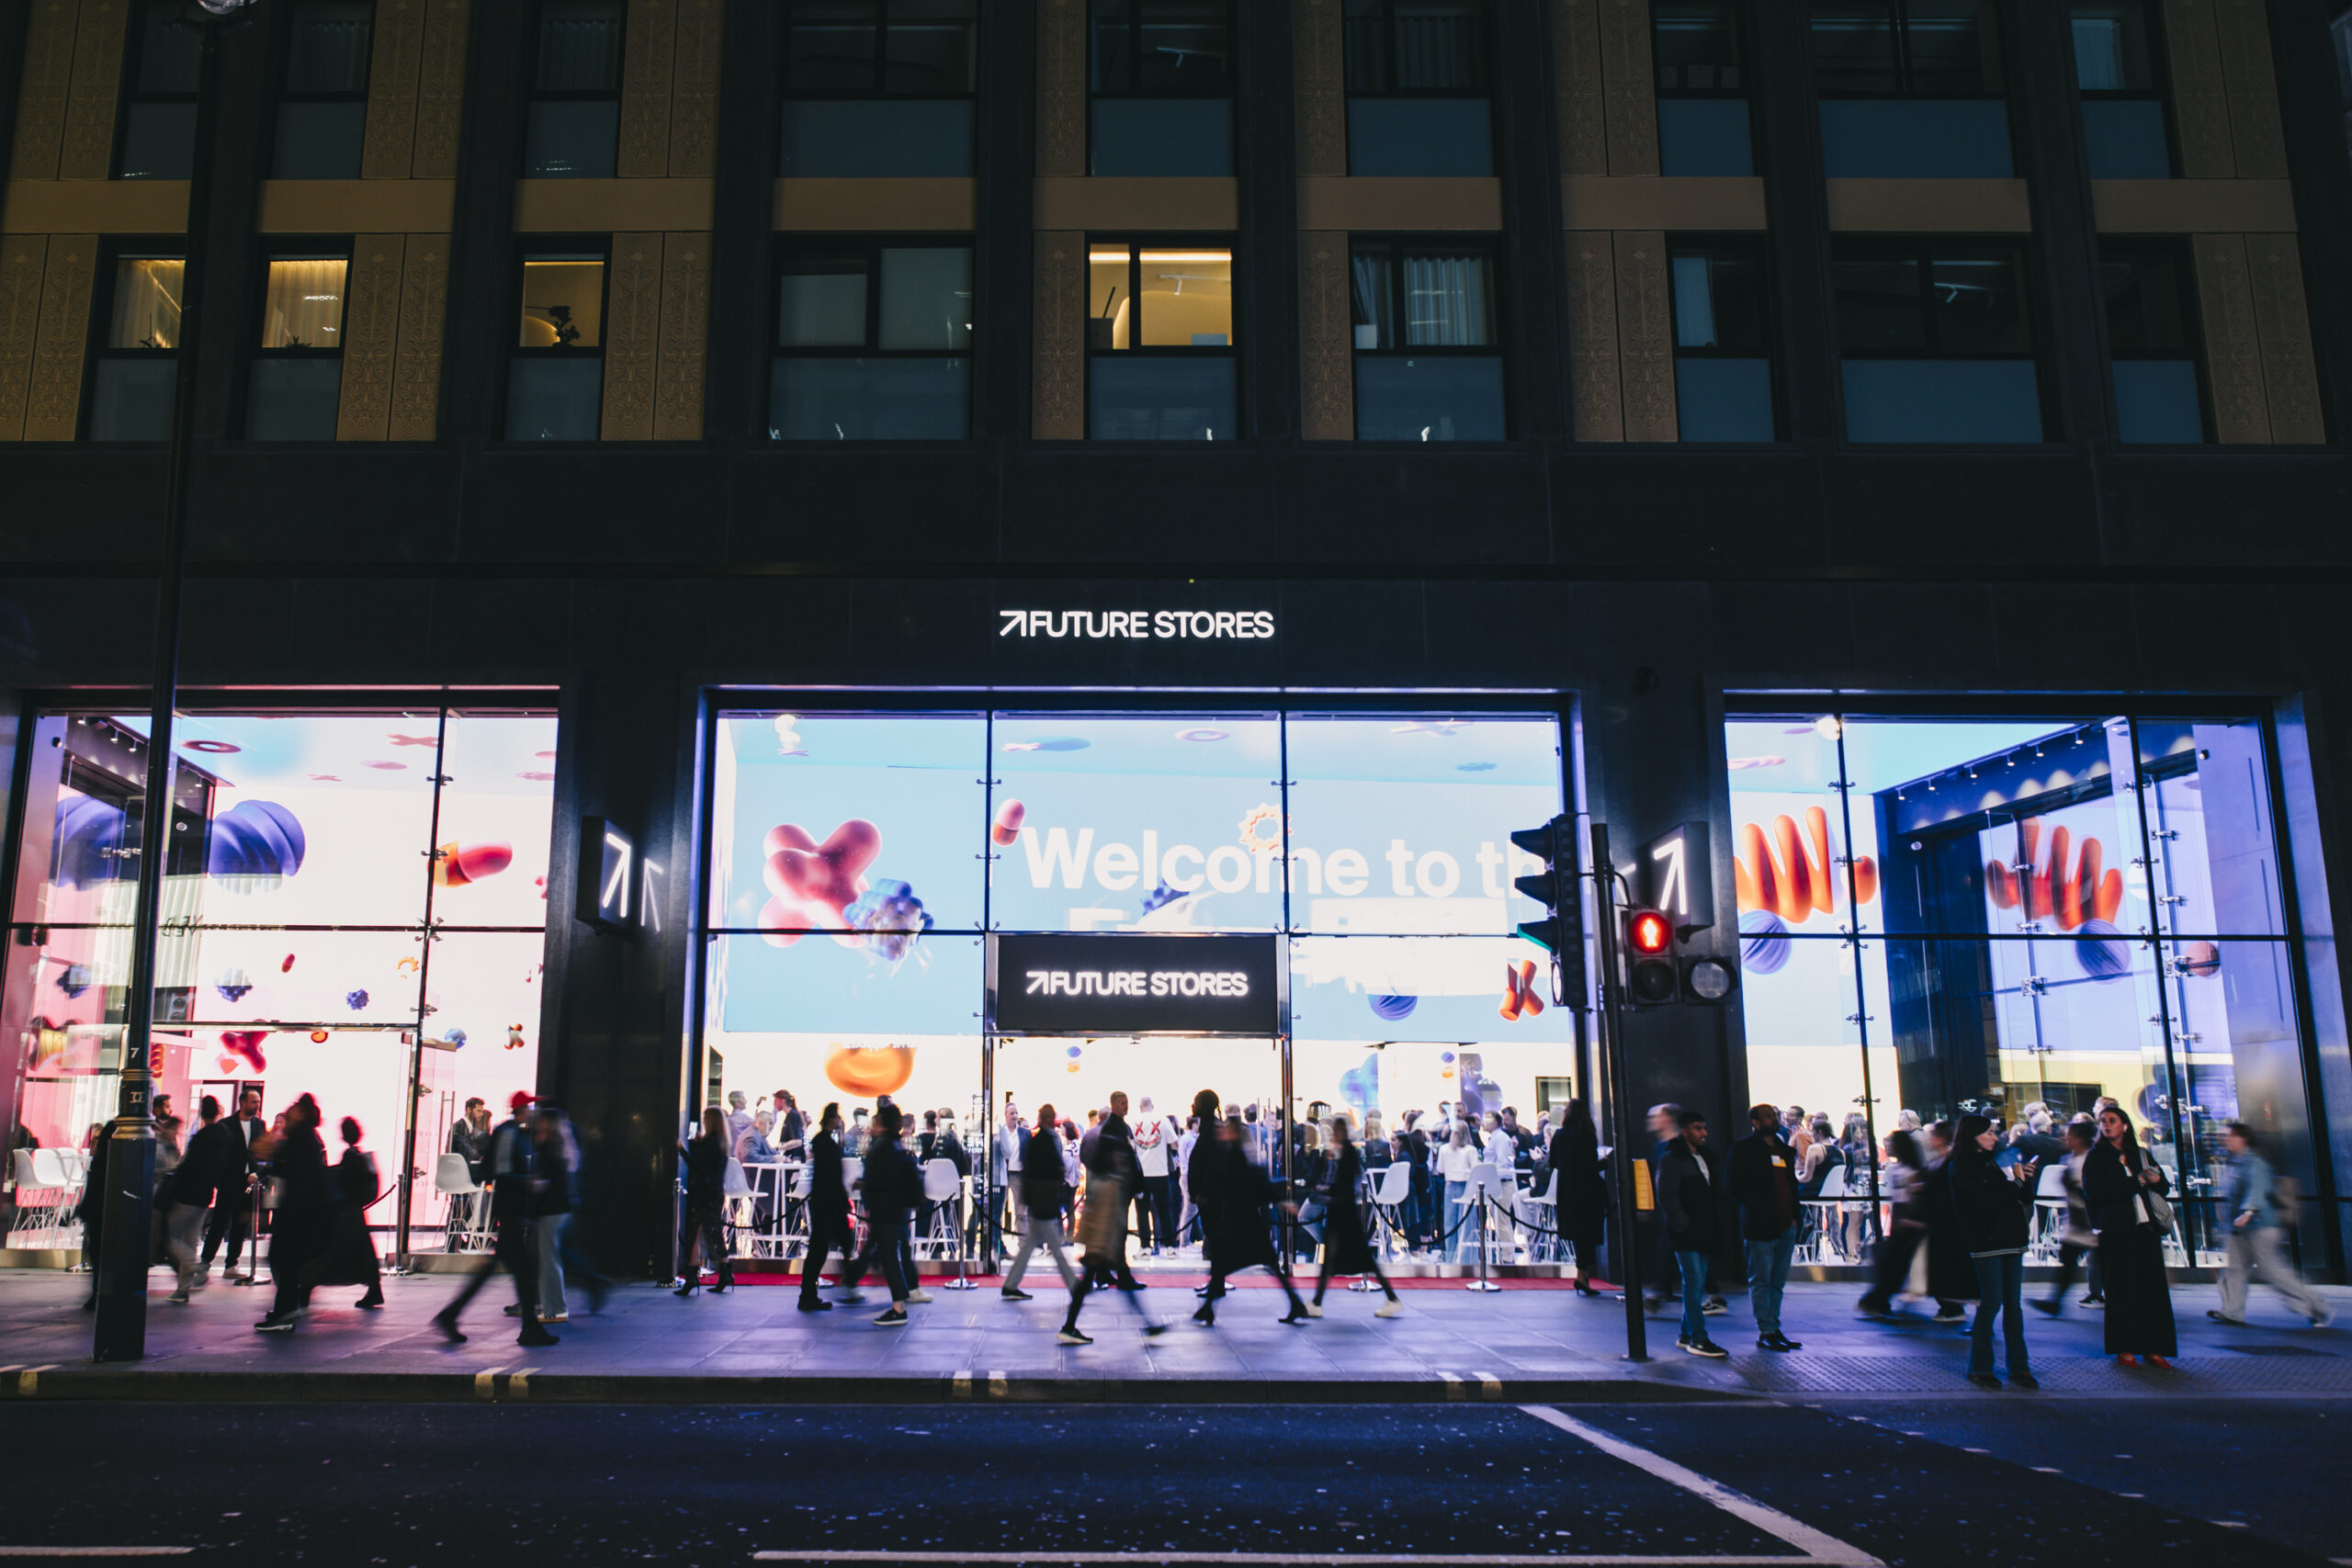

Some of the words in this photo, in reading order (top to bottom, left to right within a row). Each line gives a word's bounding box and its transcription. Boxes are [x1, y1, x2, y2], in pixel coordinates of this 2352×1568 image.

[1030, 611, 1148, 637] FUTURE
[1154, 611, 1274, 637] STORES
[1022, 827, 1369, 896] Welcome
[1385, 839, 1461, 898] to
[1050, 972, 1147, 996] FUTURE
[1150, 972, 1249, 996] STORES
[130, 1047, 140, 1059] 7
